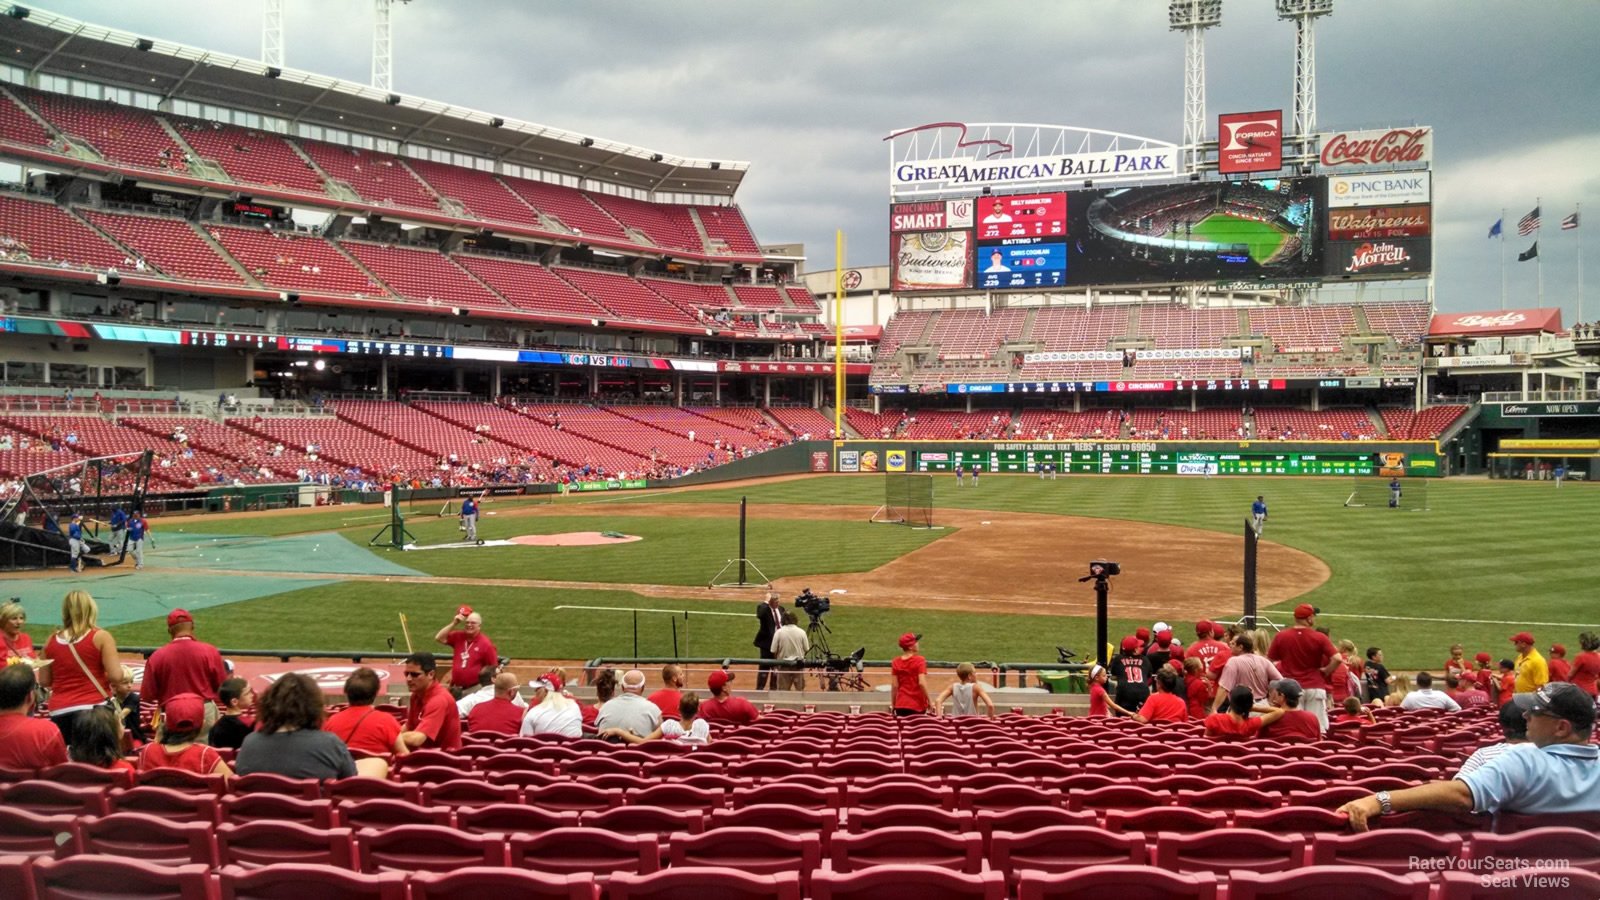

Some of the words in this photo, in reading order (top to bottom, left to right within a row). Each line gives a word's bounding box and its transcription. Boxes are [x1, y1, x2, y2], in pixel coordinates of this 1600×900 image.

[1321, 129, 1429, 166] Coca-Cola
[897, 165, 961, 181] GREAT
[955, 162, 1054, 183] AMERICAN
[1060, 157, 1110, 176] BALL
[1114, 154, 1170, 172] PARK
[1352, 181, 1380, 192] PNC
[1385, 178, 1423, 189] BANK
[894, 202, 944, 213] CINCINNATI
[894, 213, 944, 229] SMART
[1331, 214, 1425, 233] Walgreens
[1370, 243, 1394, 254] John
[898, 252, 966, 267] Budweiser
[1345, 247, 1411, 272] Morrell
[1218, 282, 1260, 291] ULTIMATE
[1453, 312, 1526, 327] Reds
[593, 356, 604, 365] VS
[1546, 405, 1561, 413] NOW
[1562, 404, 1578, 413] OPEN
[1131, 443, 1157, 451] 69050
[1199, 645, 1219, 655] VOTTO
[1121, 658, 1143, 666] VOTTO
